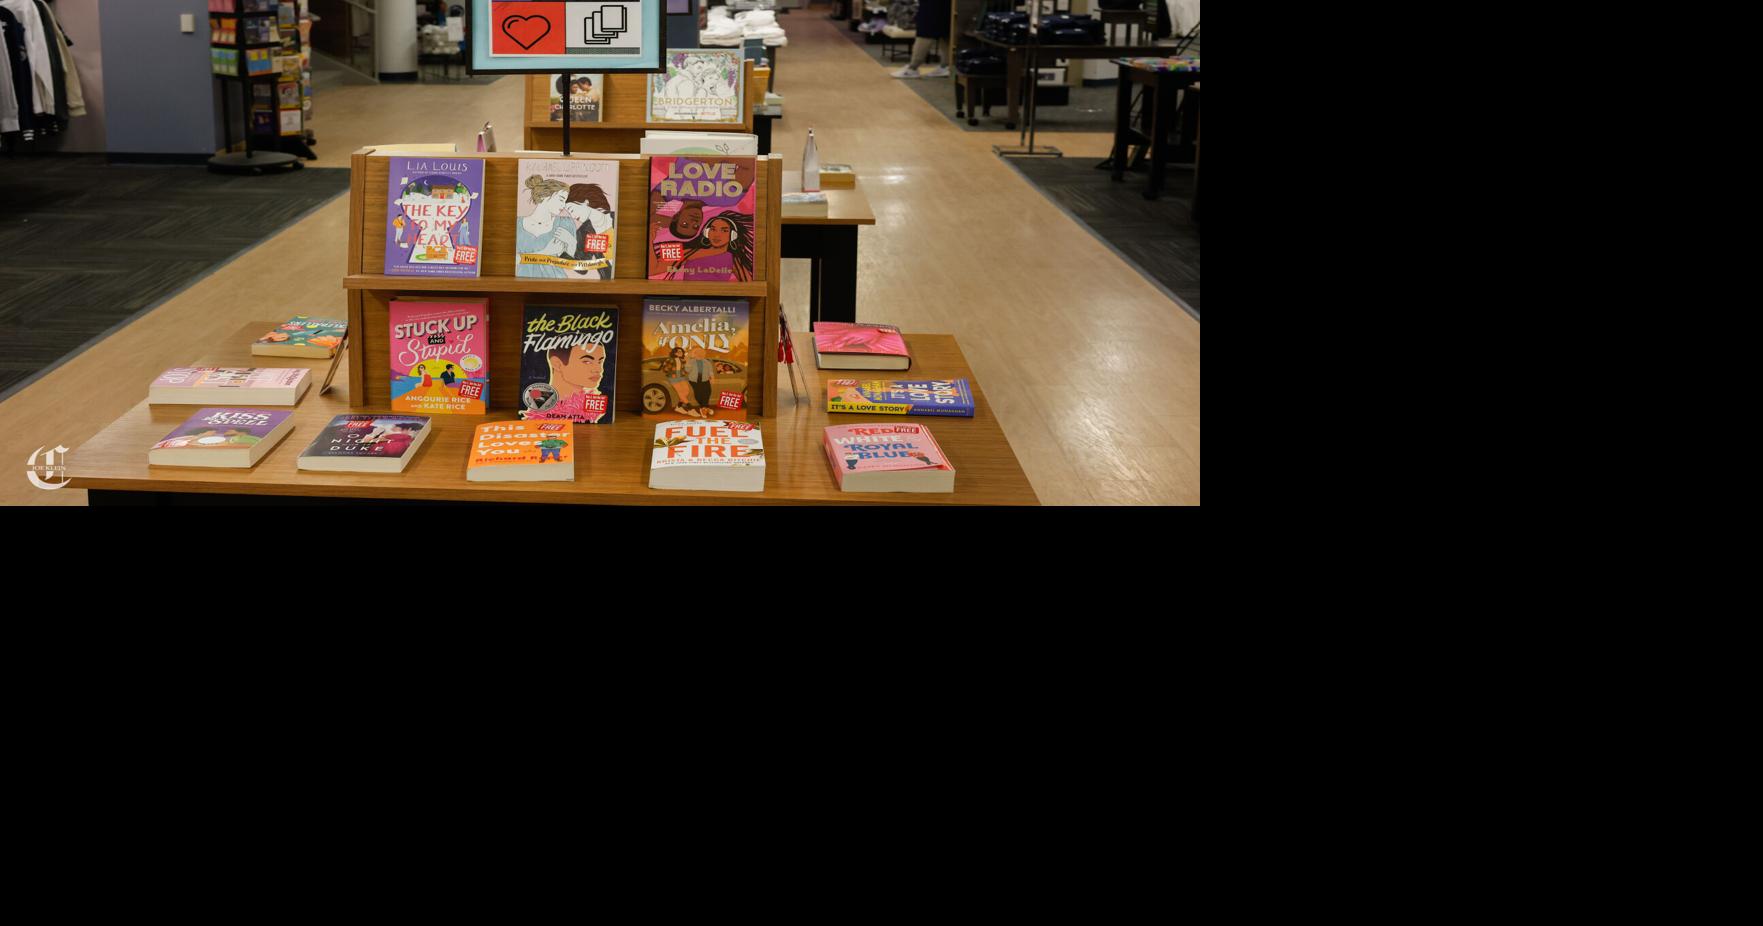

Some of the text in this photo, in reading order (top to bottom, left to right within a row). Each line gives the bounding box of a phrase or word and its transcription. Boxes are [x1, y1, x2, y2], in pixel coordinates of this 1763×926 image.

[657, 98, 733, 106] BRIDGERTON
[407, 161, 468, 172] LIA LOUIS
[668, 162, 736, 180] LOVE
[660, 180, 743, 198] RADIO
[402, 204, 468, 220] THE KEY
[411, 219, 458, 232] TO MY
[406, 234, 459, 247] HEART
[586, 238, 606, 250] FREE
[455, 250, 476, 262] FREE
[662, 248, 682, 258] FREE
[698, 266, 733, 274] LaDelle
[649, 304, 736, 313] BECKY ALBERTALLI
[394, 318, 450, 339] STUCK
[454, 314, 478, 331] UP
[527, 312, 612, 334] the Black
[654, 318, 736, 336] Amelia,
[523, 330, 614, 354] Flamingo
[668, 334, 730, 354] ONLY
[398, 333, 474, 366] Stupid
[460, 384, 481, 397] FREE
[908, 384, 931, 401] LOVE
[932, 382, 956, 404] STORY
[586, 400, 606, 410] FREE
[720, 396, 740, 408] FREE
[481, 424, 526, 432] This
[666, 426, 749, 438] FUEL
[848, 428, 894, 436] RED
[478, 440, 542, 448] Loves
[834, 435, 903, 444] WHITE
[477, 448, 520, 456] You
[667, 445, 750, 458] FIRE
[844, 442, 919, 452] ROYAL
[858, 450, 910, 460] BLUE
